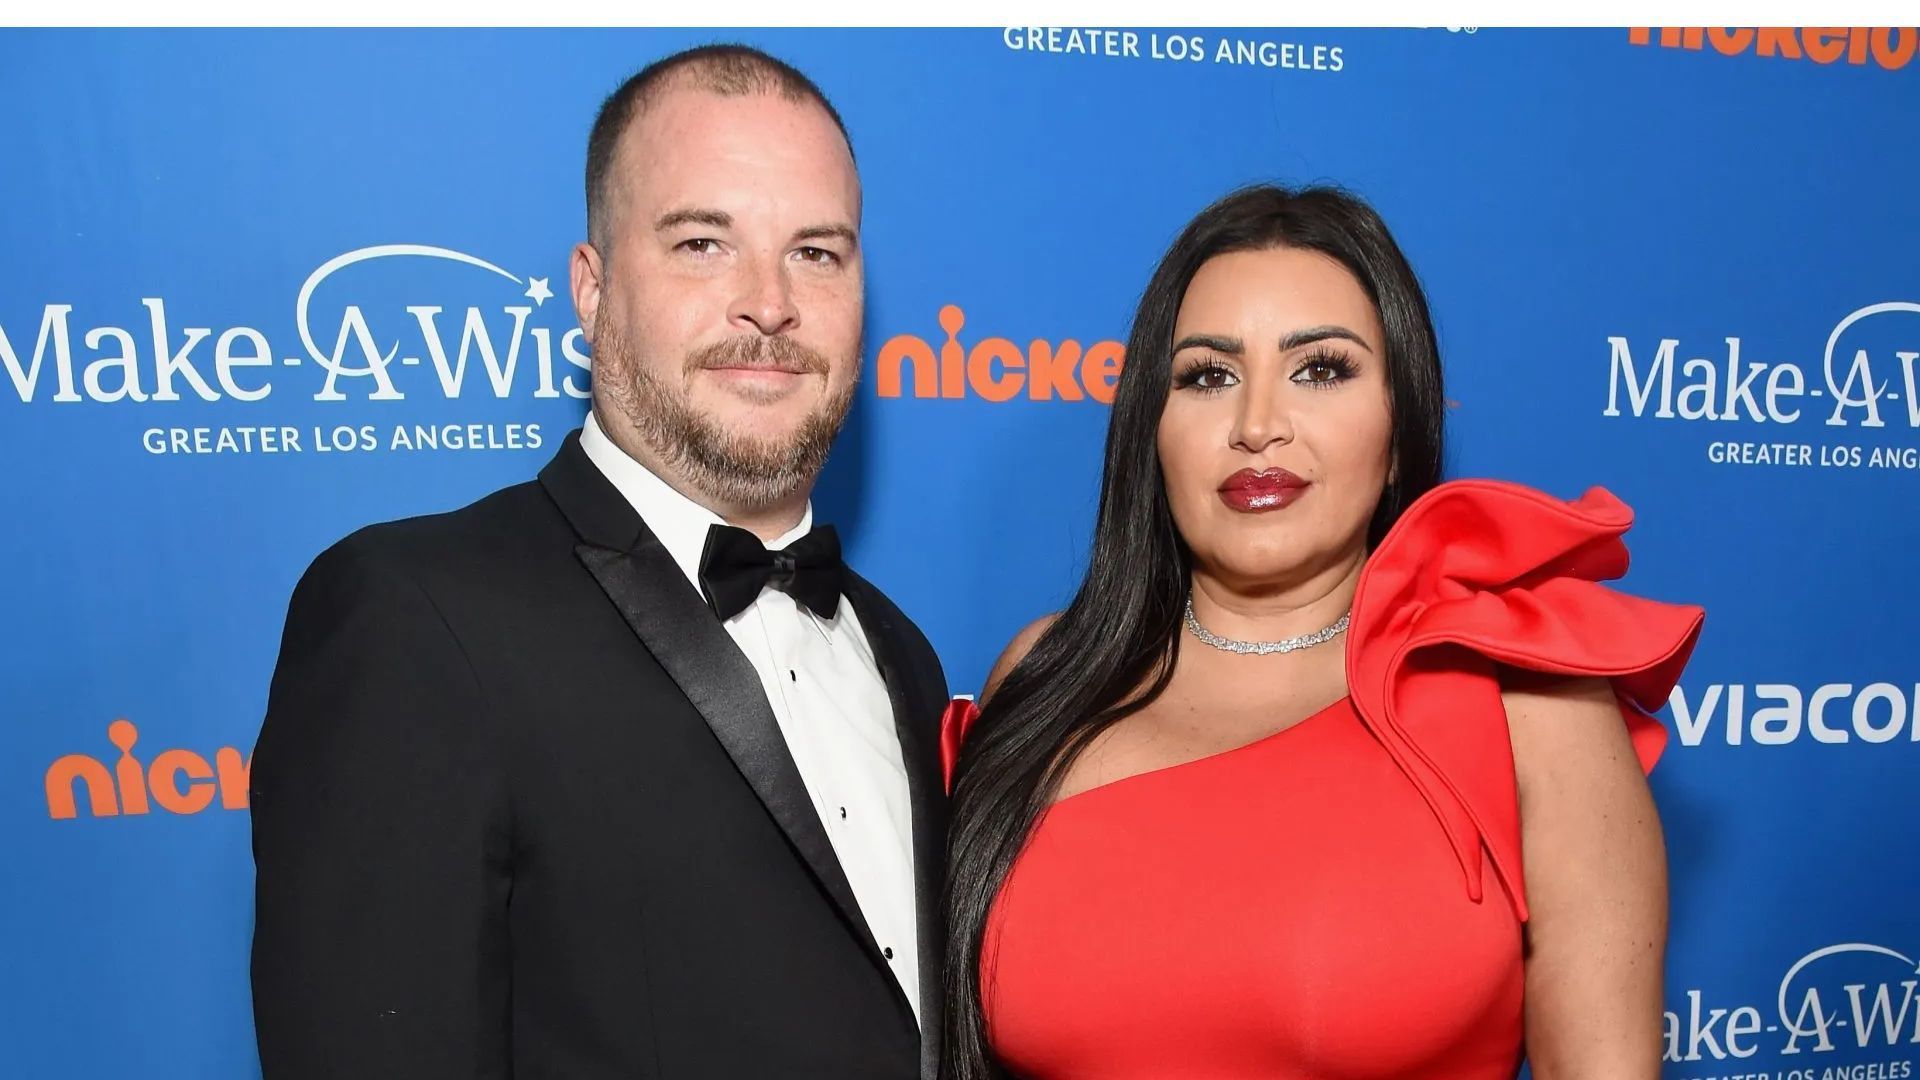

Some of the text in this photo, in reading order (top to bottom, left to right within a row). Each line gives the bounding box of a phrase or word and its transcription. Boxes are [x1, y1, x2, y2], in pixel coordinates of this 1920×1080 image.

[1003, 27, 1344, 71] GREATER LOS ANGELES
[1629, 27, 1920, 70] ckelo
[1603, 335, 1920, 428] Make-A-
[142, 423, 542, 454] GREATER LOS ANGELES
[1708, 441, 1920, 469] GREATER LOS ANG
